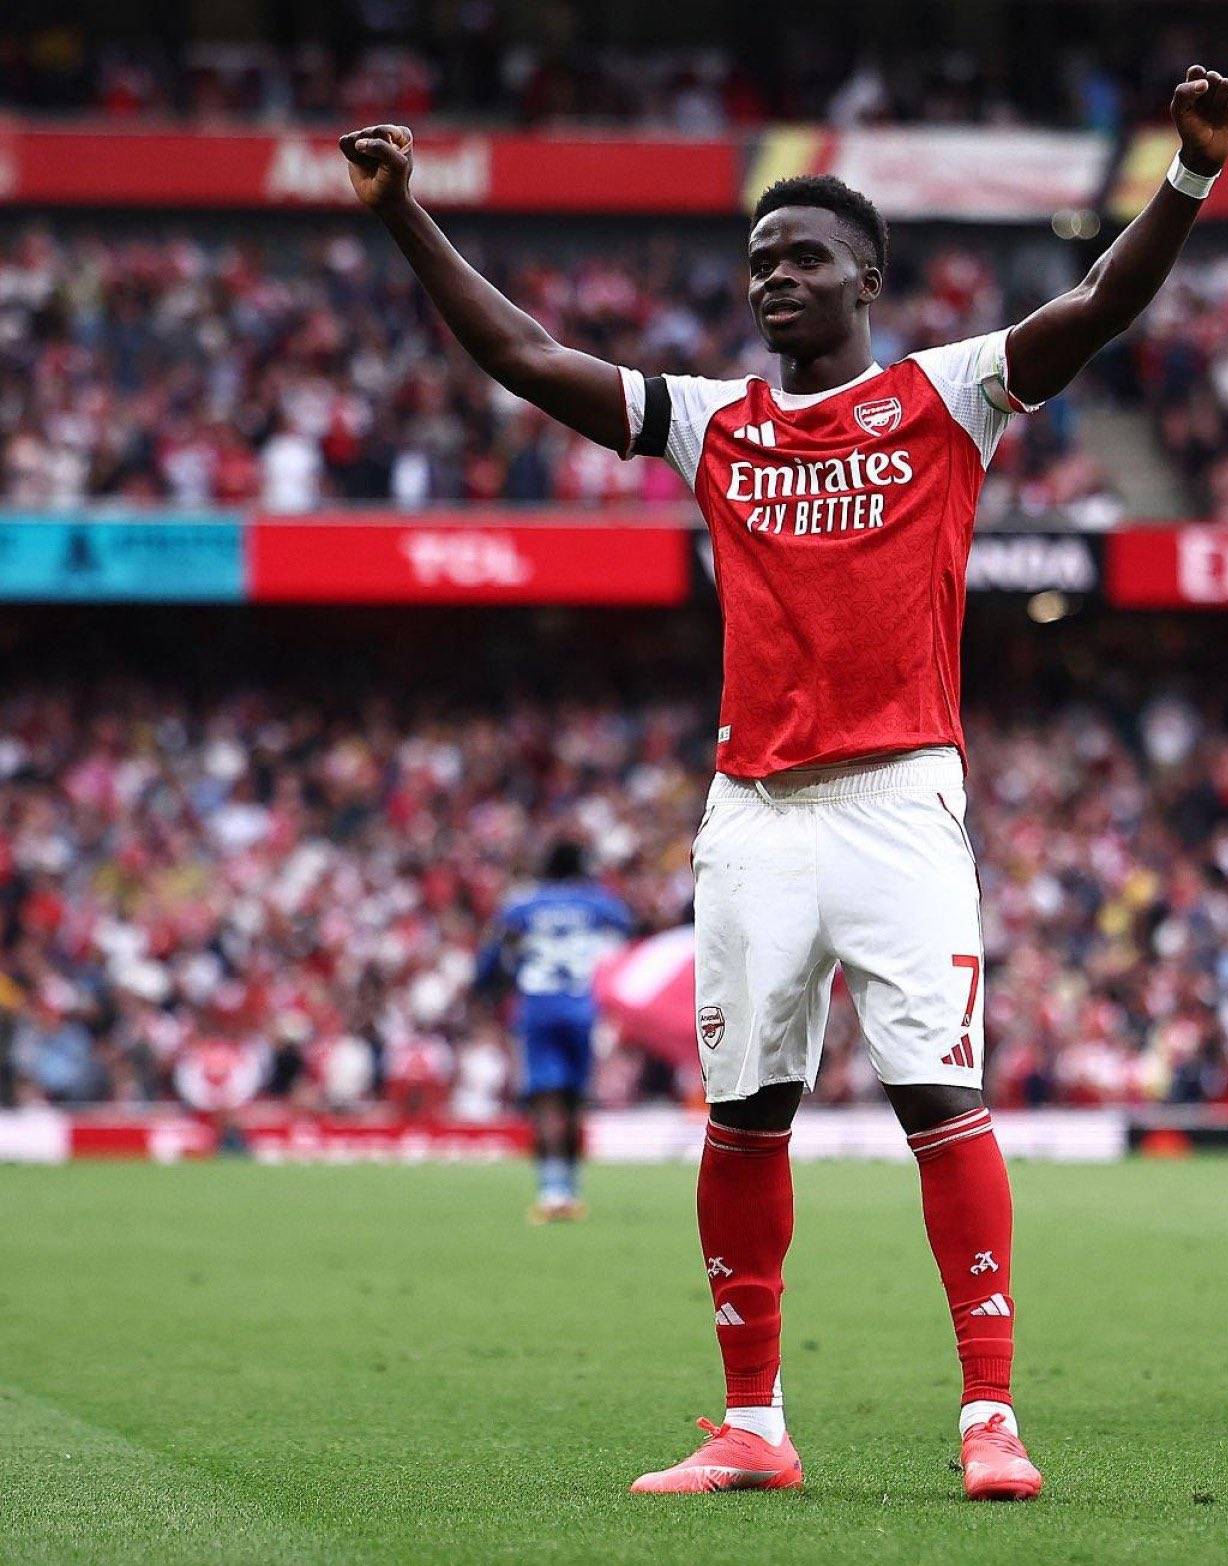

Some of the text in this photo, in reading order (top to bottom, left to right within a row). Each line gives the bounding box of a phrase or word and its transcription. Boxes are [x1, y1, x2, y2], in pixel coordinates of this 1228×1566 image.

[726, 448, 913, 501] Emirates
[747, 494, 884, 536] FLY BETTER
[951, 954, 980, 1027] 7
